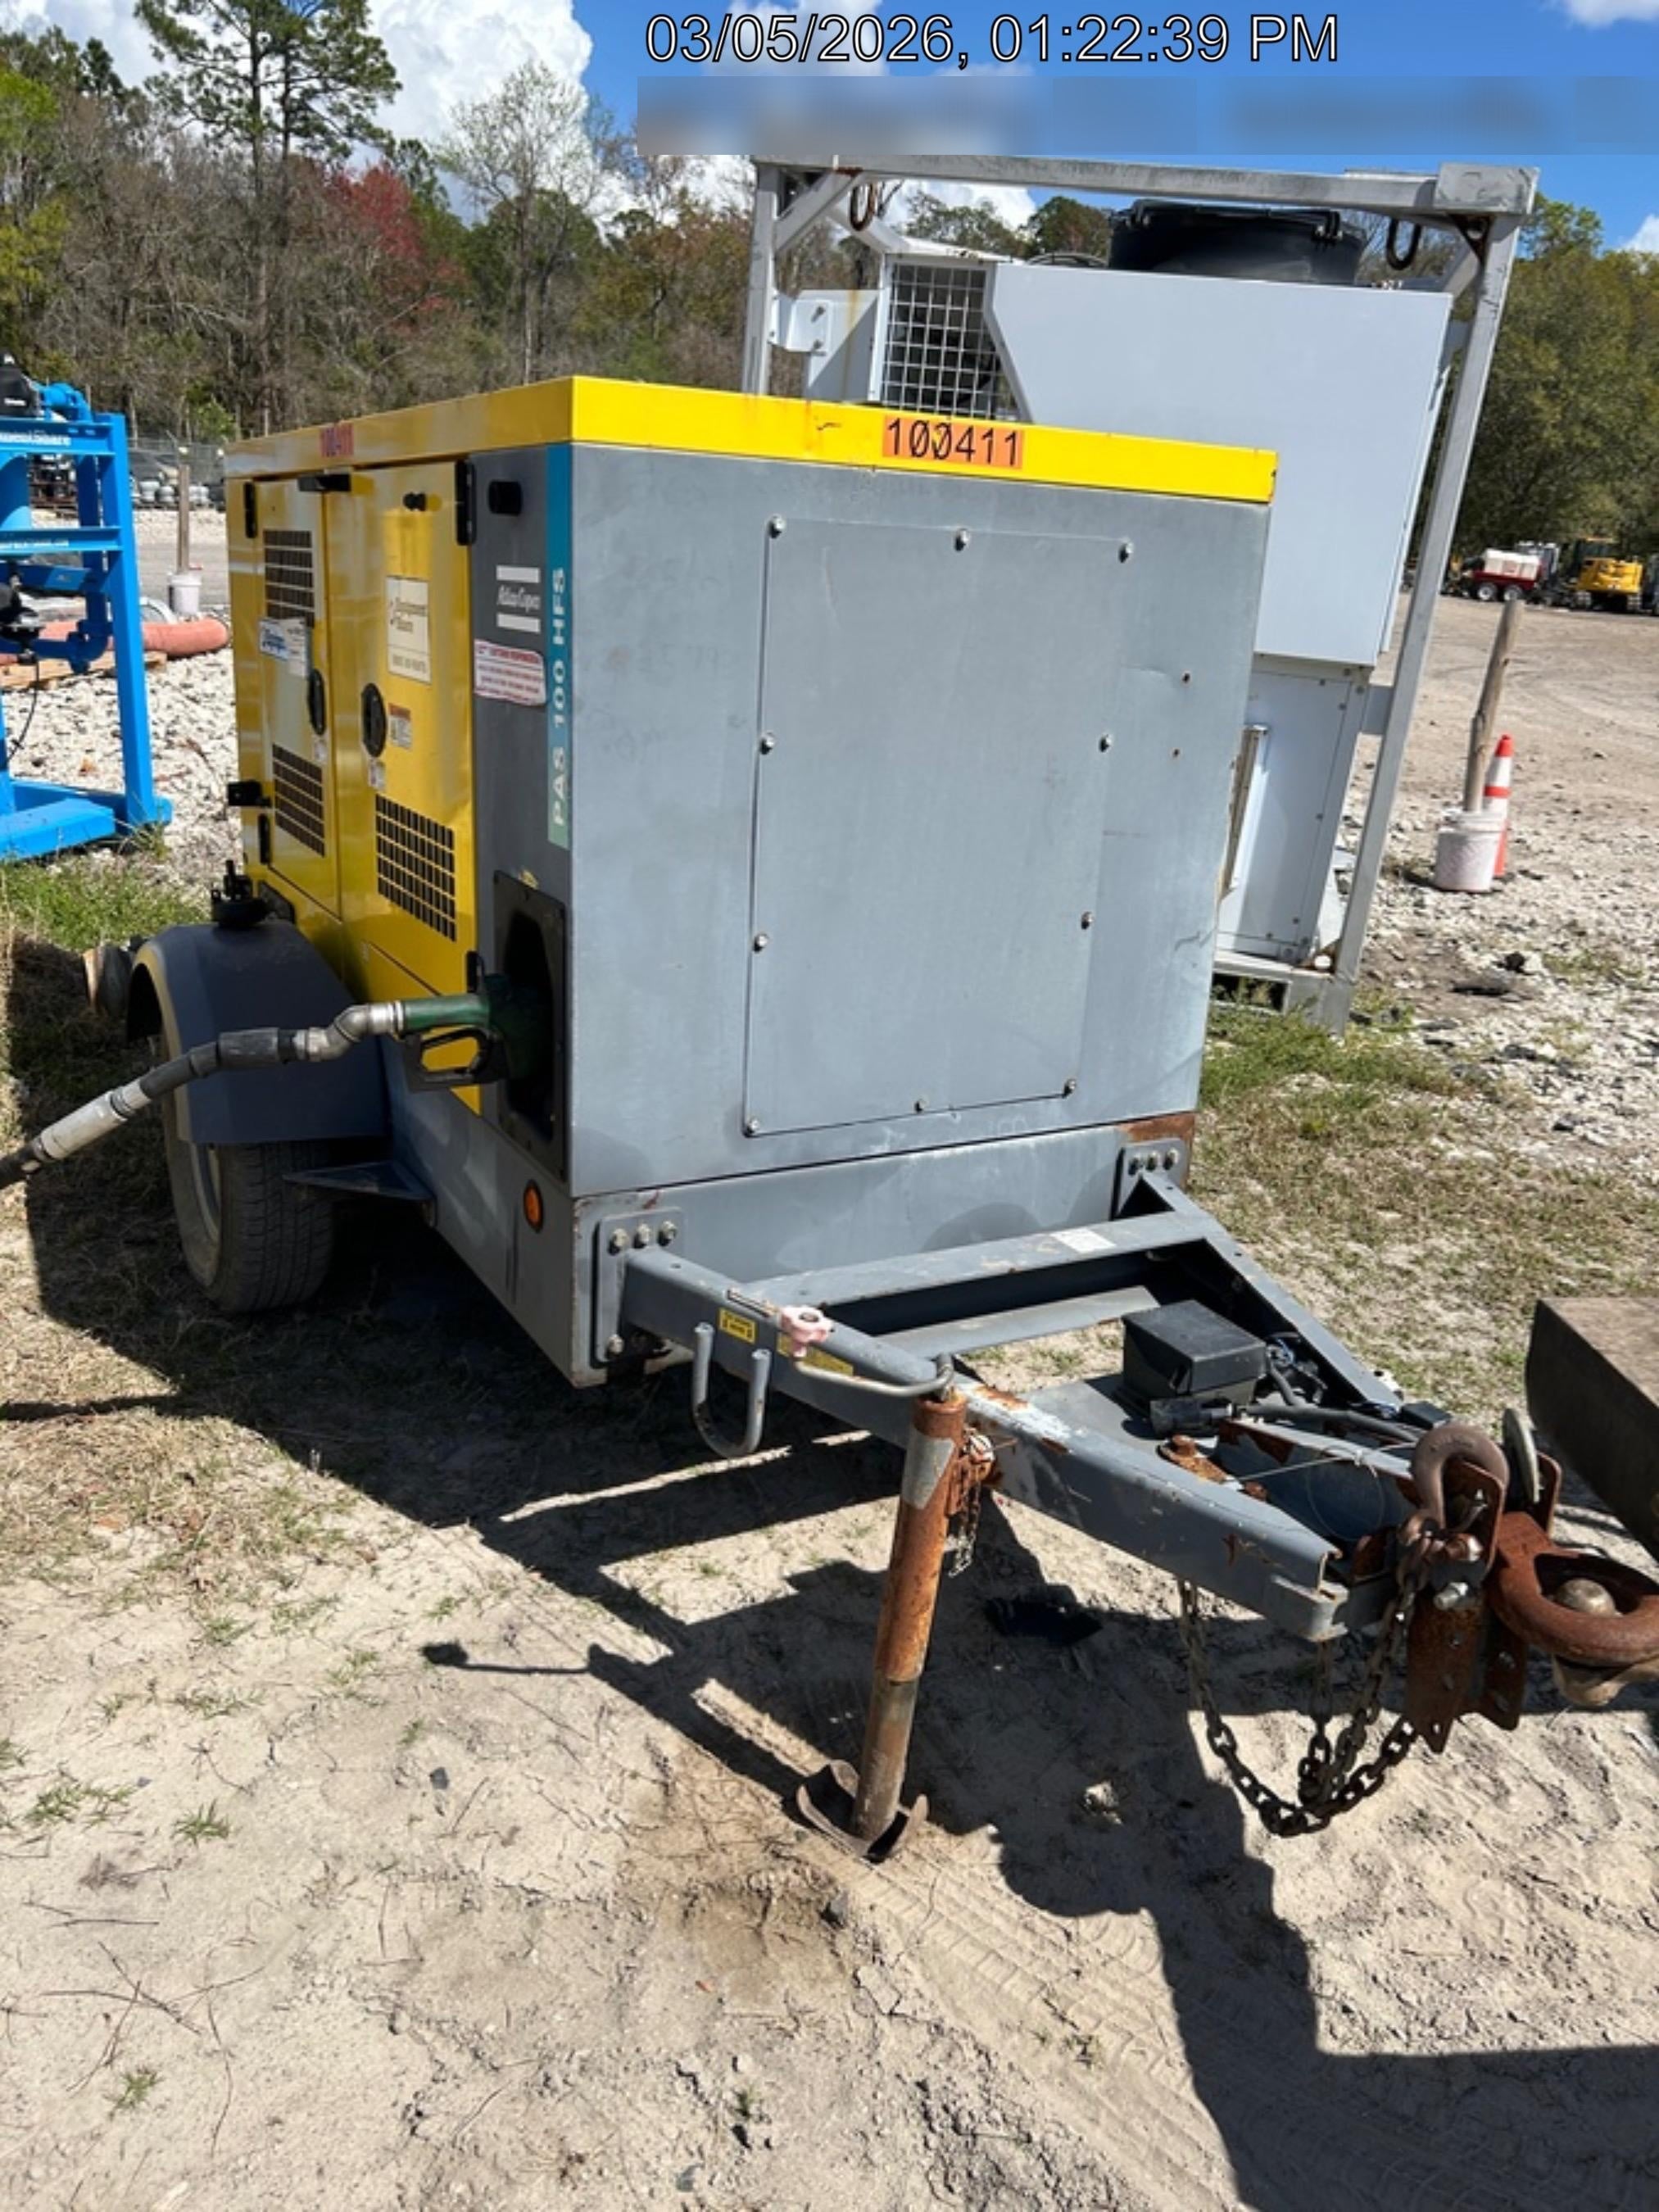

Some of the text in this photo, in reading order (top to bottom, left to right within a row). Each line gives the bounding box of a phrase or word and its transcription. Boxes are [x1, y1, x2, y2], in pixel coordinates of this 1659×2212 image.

[887, 418, 1018, 466] 100411
[552, 568, 565, 827] PAS 100 HFS
